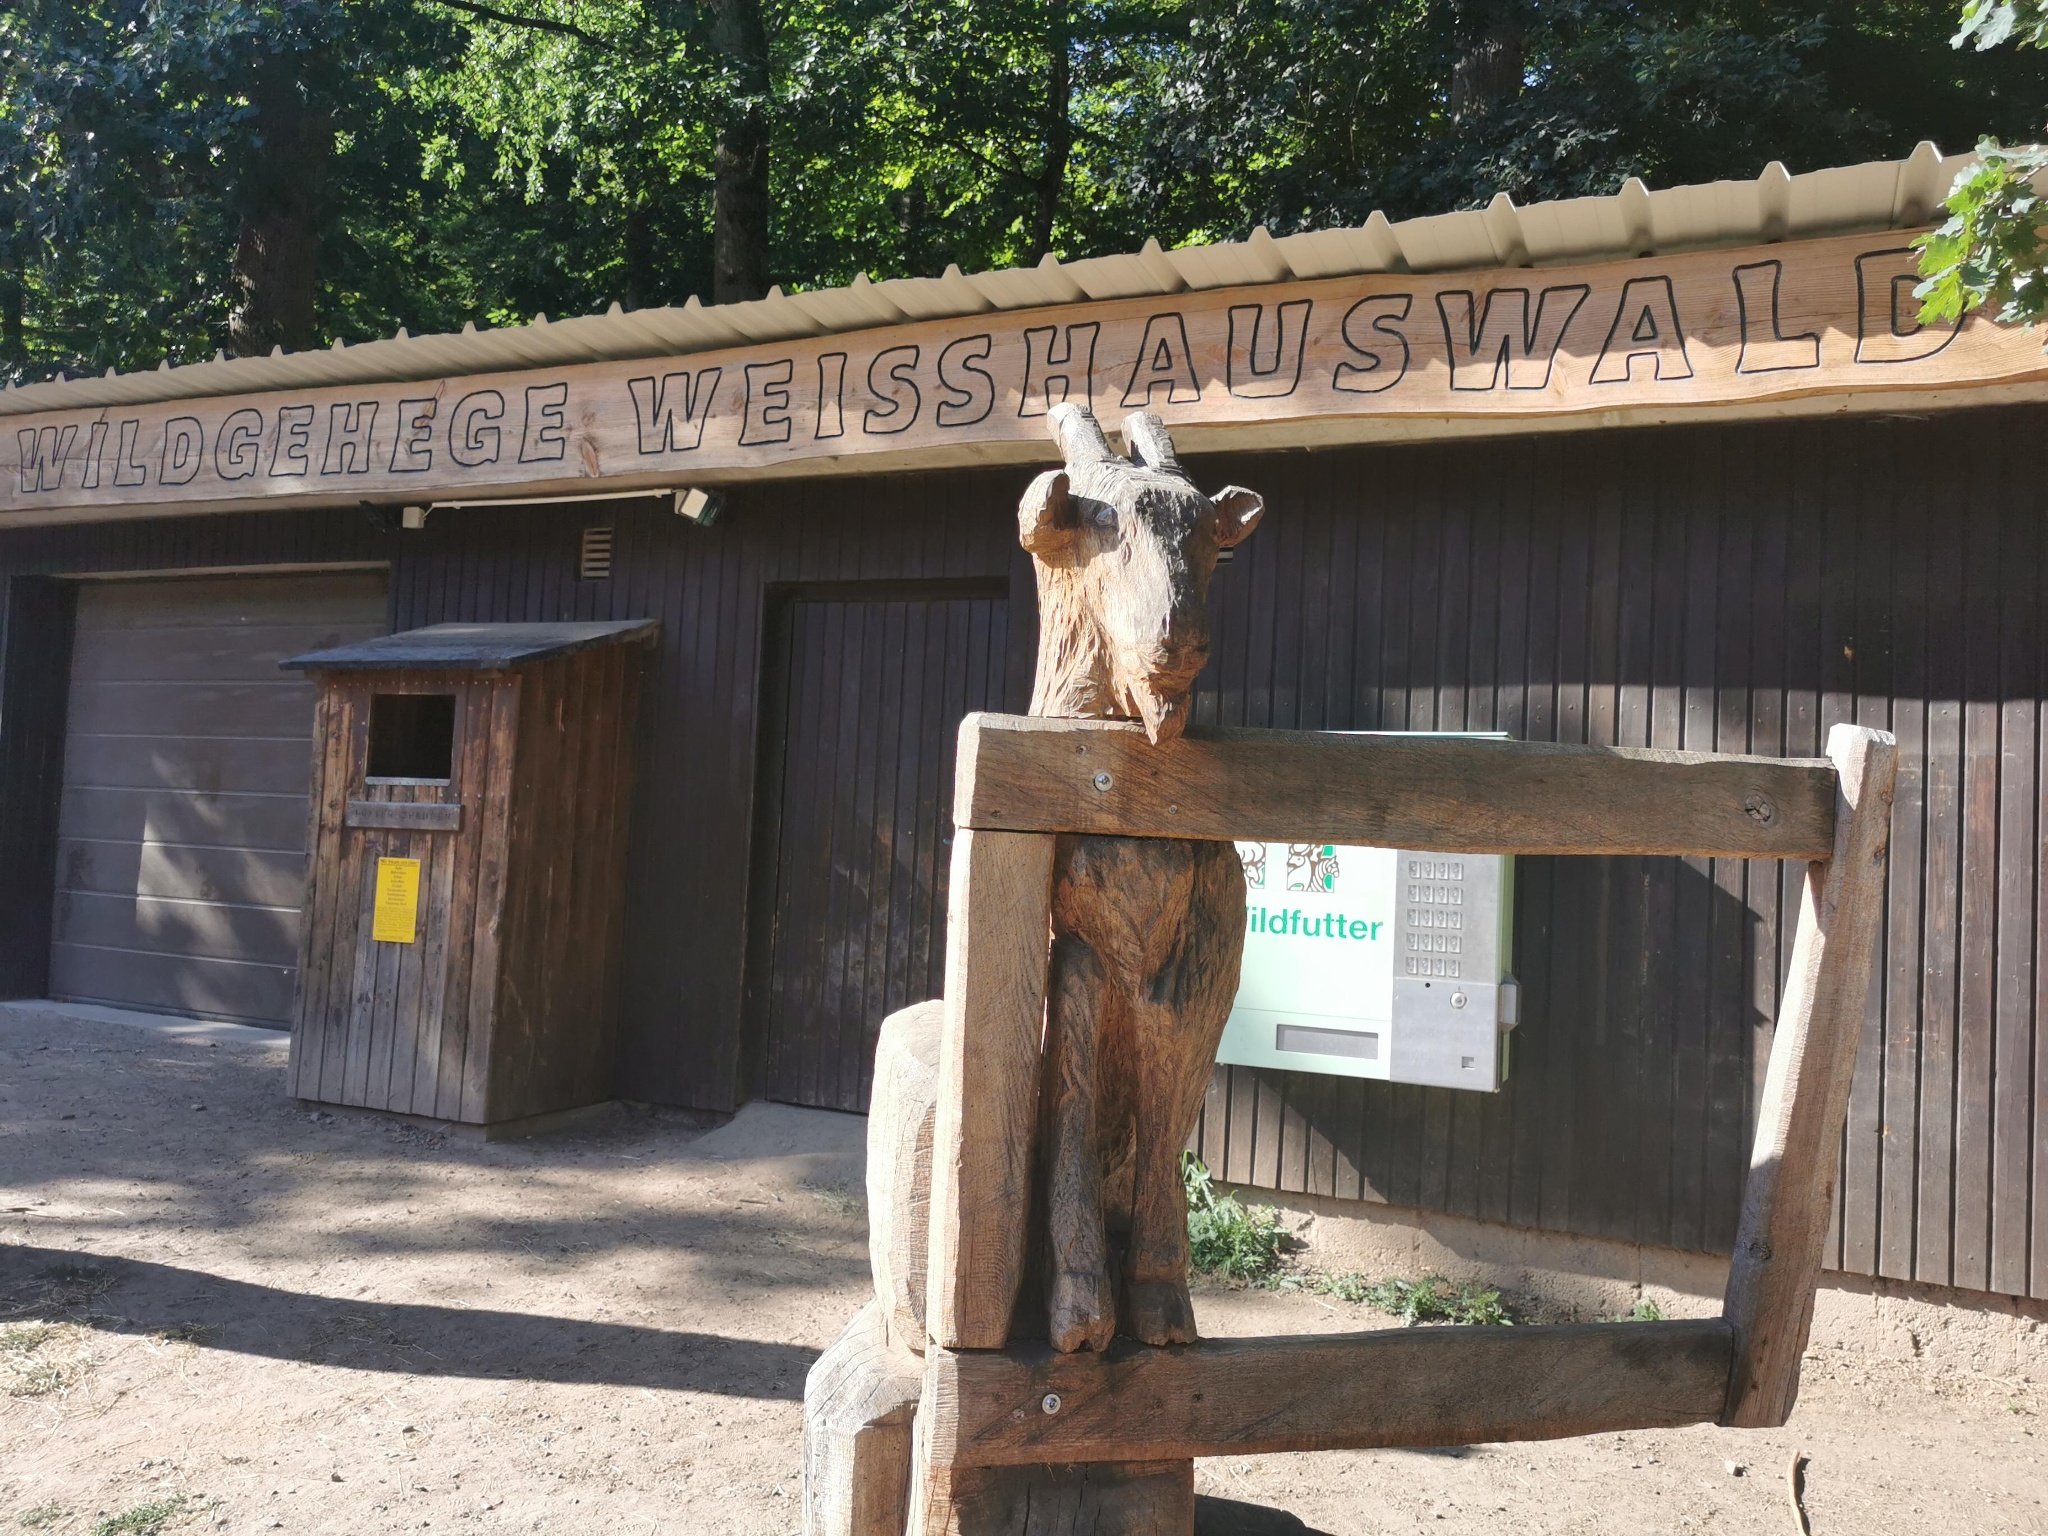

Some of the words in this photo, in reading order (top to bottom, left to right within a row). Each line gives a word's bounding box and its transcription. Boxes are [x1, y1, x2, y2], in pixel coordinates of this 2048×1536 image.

[16, 382, 569, 493] WILDGEHEGE
[627, 245, 1967, 456] WEISSHAUSWALD
[1245, 906, 1384, 940] ildfutter
